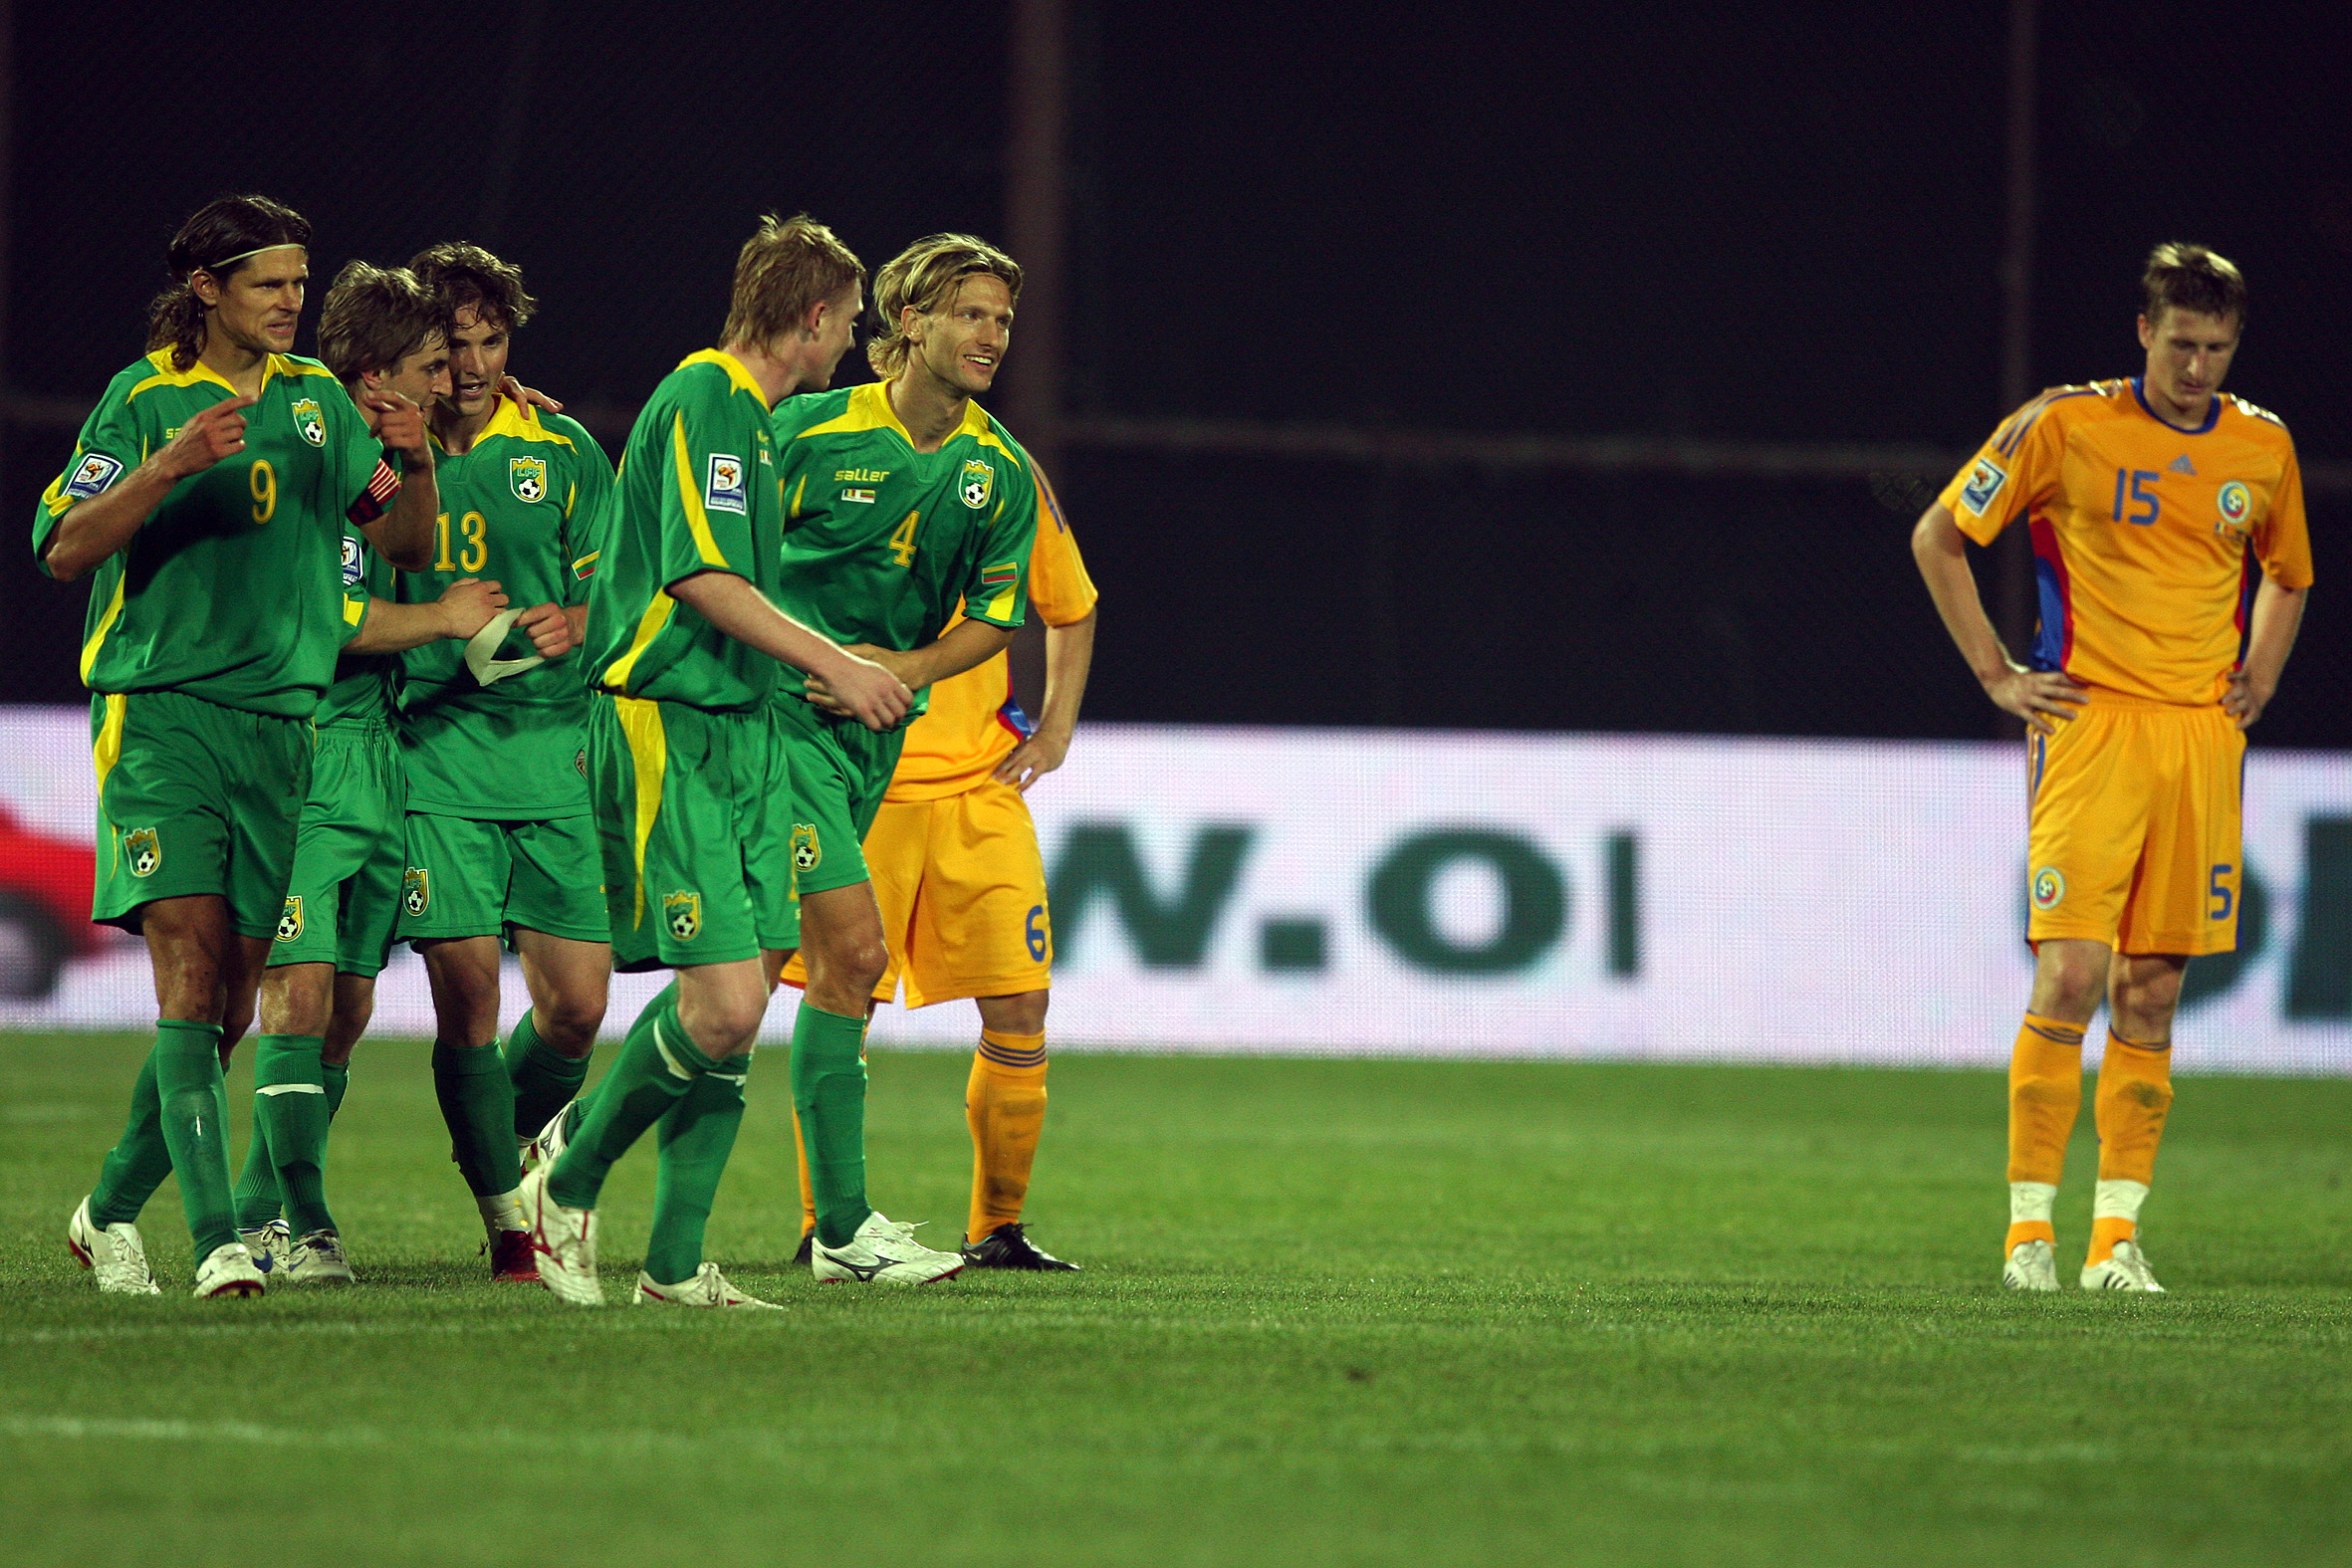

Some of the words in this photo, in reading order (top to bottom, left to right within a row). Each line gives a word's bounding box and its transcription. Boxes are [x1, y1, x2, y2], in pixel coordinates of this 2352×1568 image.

[249, 459, 277, 525] 9
[516, 467, 541, 477] LFF
[833, 468, 890, 482] saller
[2112, 467, 2161, 527] 15
[434, 511, 488, 573] 13
[888, 510, 920, 567] 4
[2210, 863, 2233, 921] 5
[1025, 904, 1047, 963] 6
